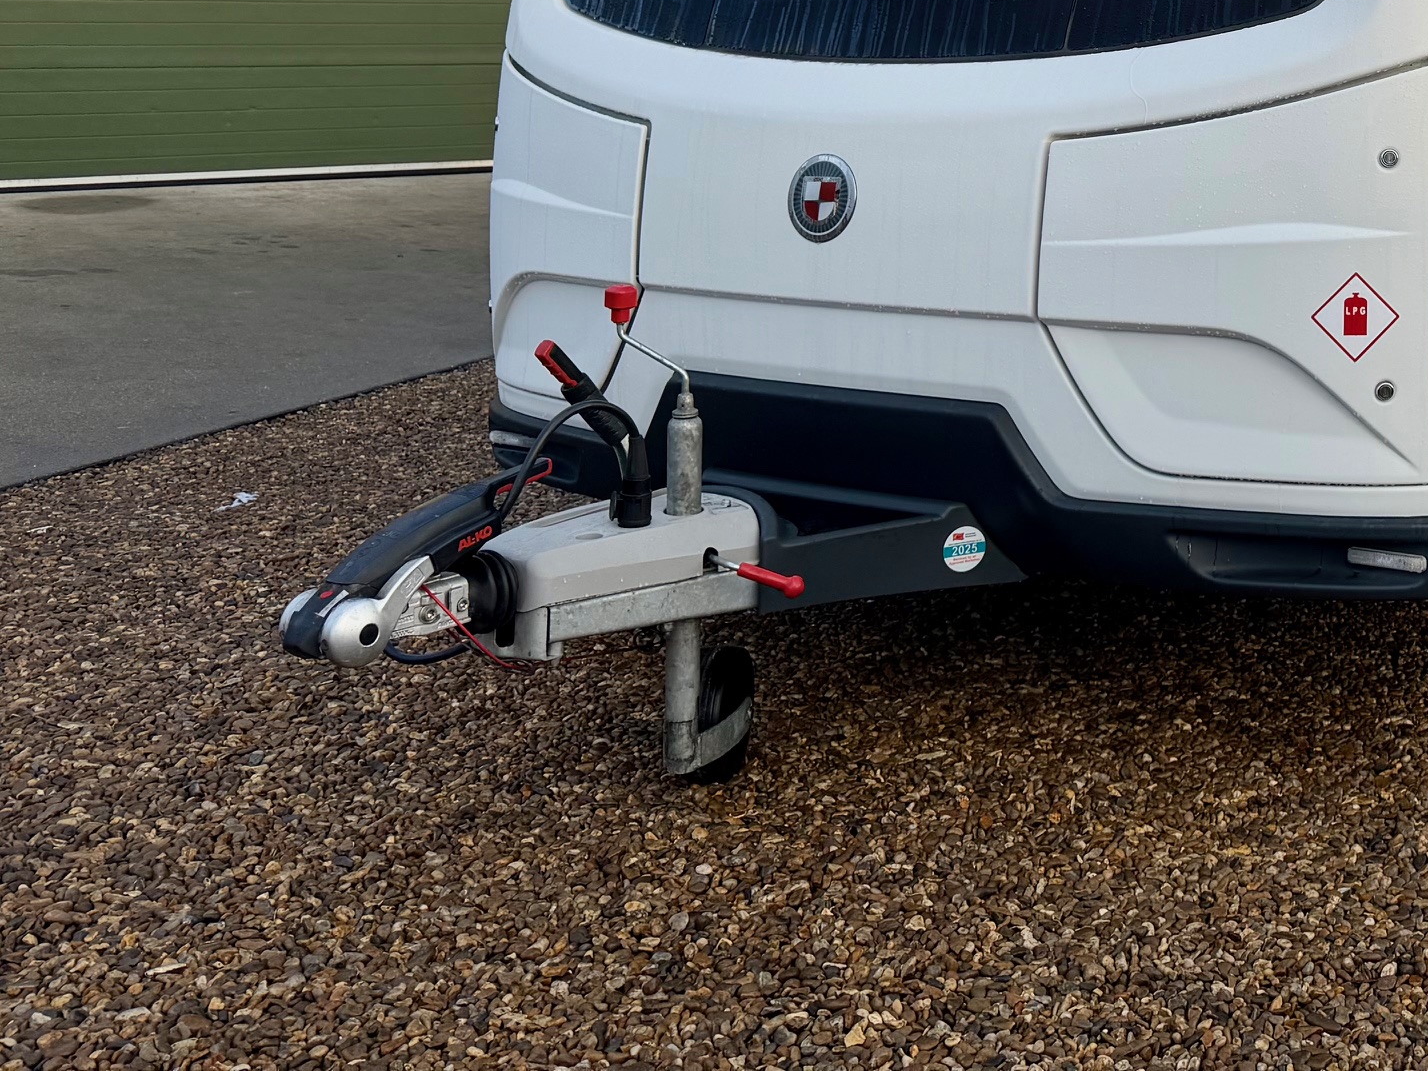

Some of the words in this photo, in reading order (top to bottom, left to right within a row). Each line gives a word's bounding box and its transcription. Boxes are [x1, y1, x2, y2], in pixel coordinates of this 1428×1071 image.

[1345, 306, 1366, 316] LPG
[457, 525, 493, 552] AL-KO
[952, 543, 978, 556] 2025
